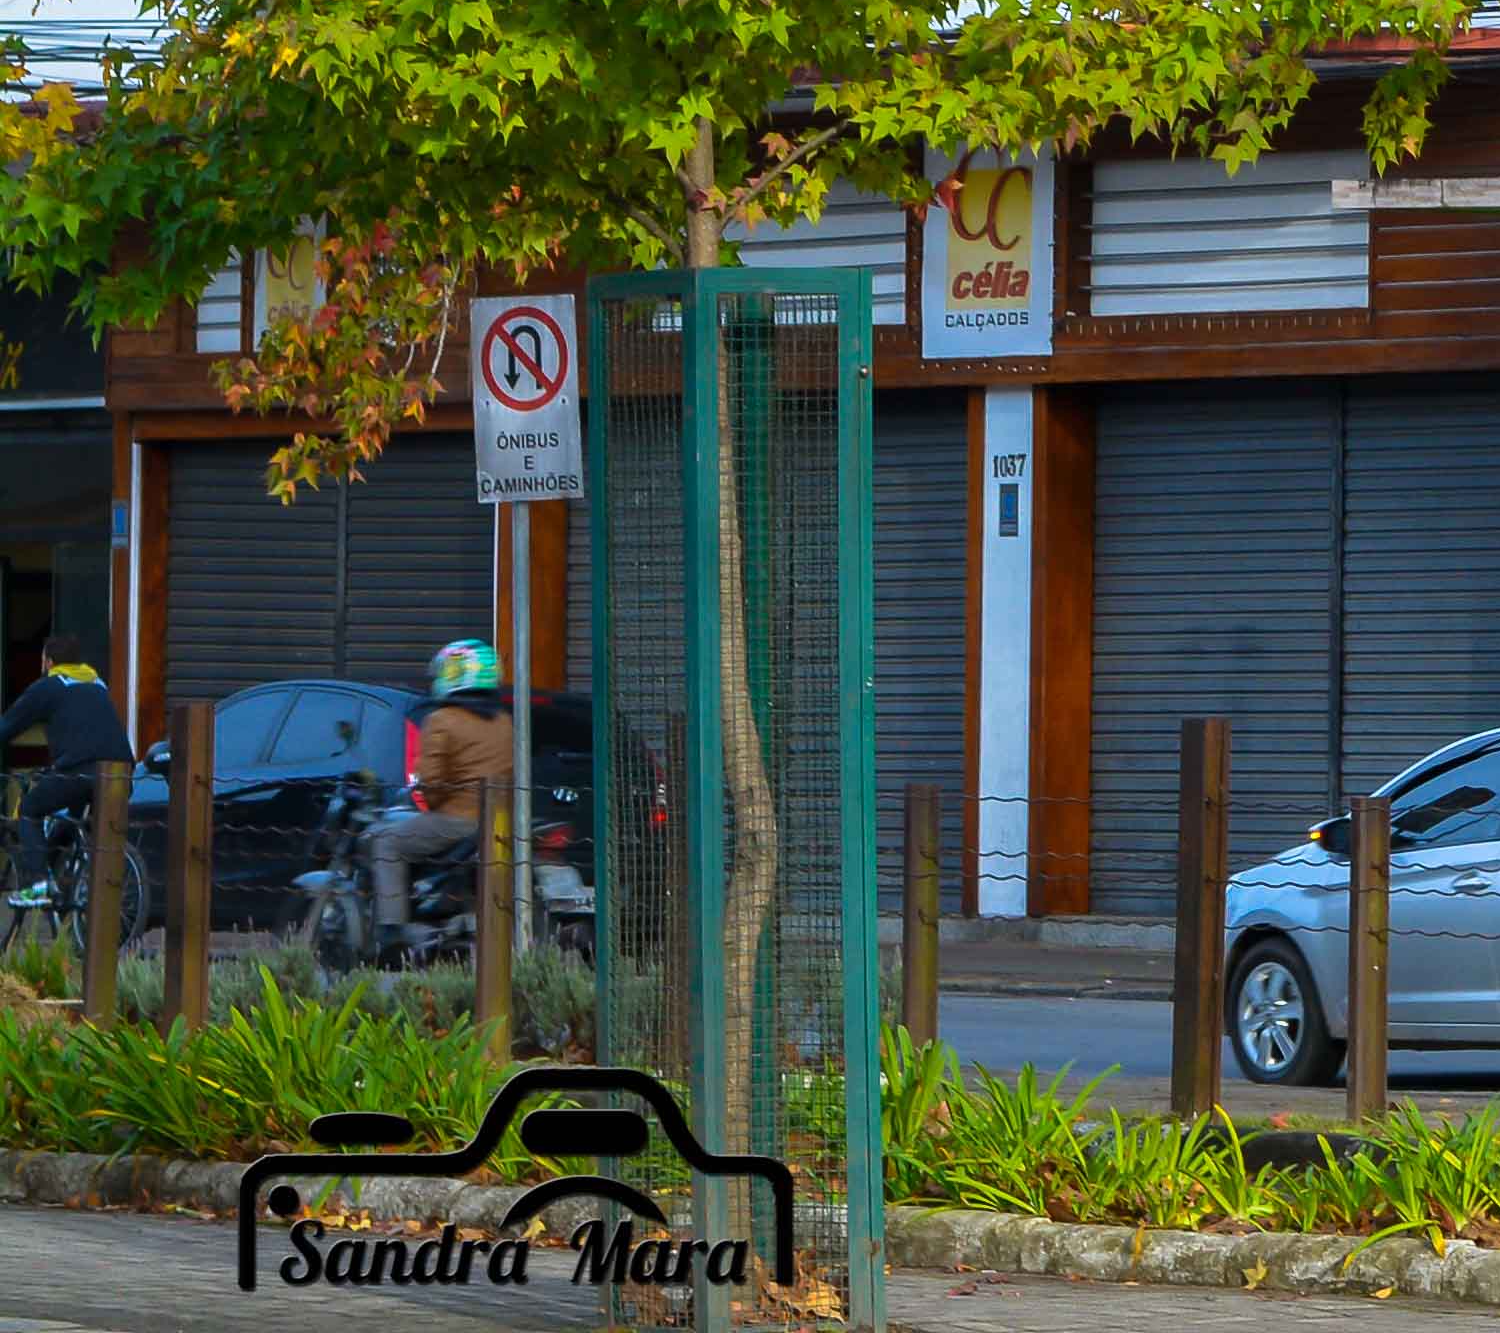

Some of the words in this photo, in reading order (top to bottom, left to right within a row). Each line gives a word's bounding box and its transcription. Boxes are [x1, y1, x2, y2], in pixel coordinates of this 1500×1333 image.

[951, 260, 1031, 301] célia
[944, 310, 1030, 334] CALÇADOS
[497, 431, 560, 450] ÔNIBUS
[524, 455, 535, 471] E
[993, 453, 1027, 478] 1037
[481, 473, 580, 494] CAMINHÕES
